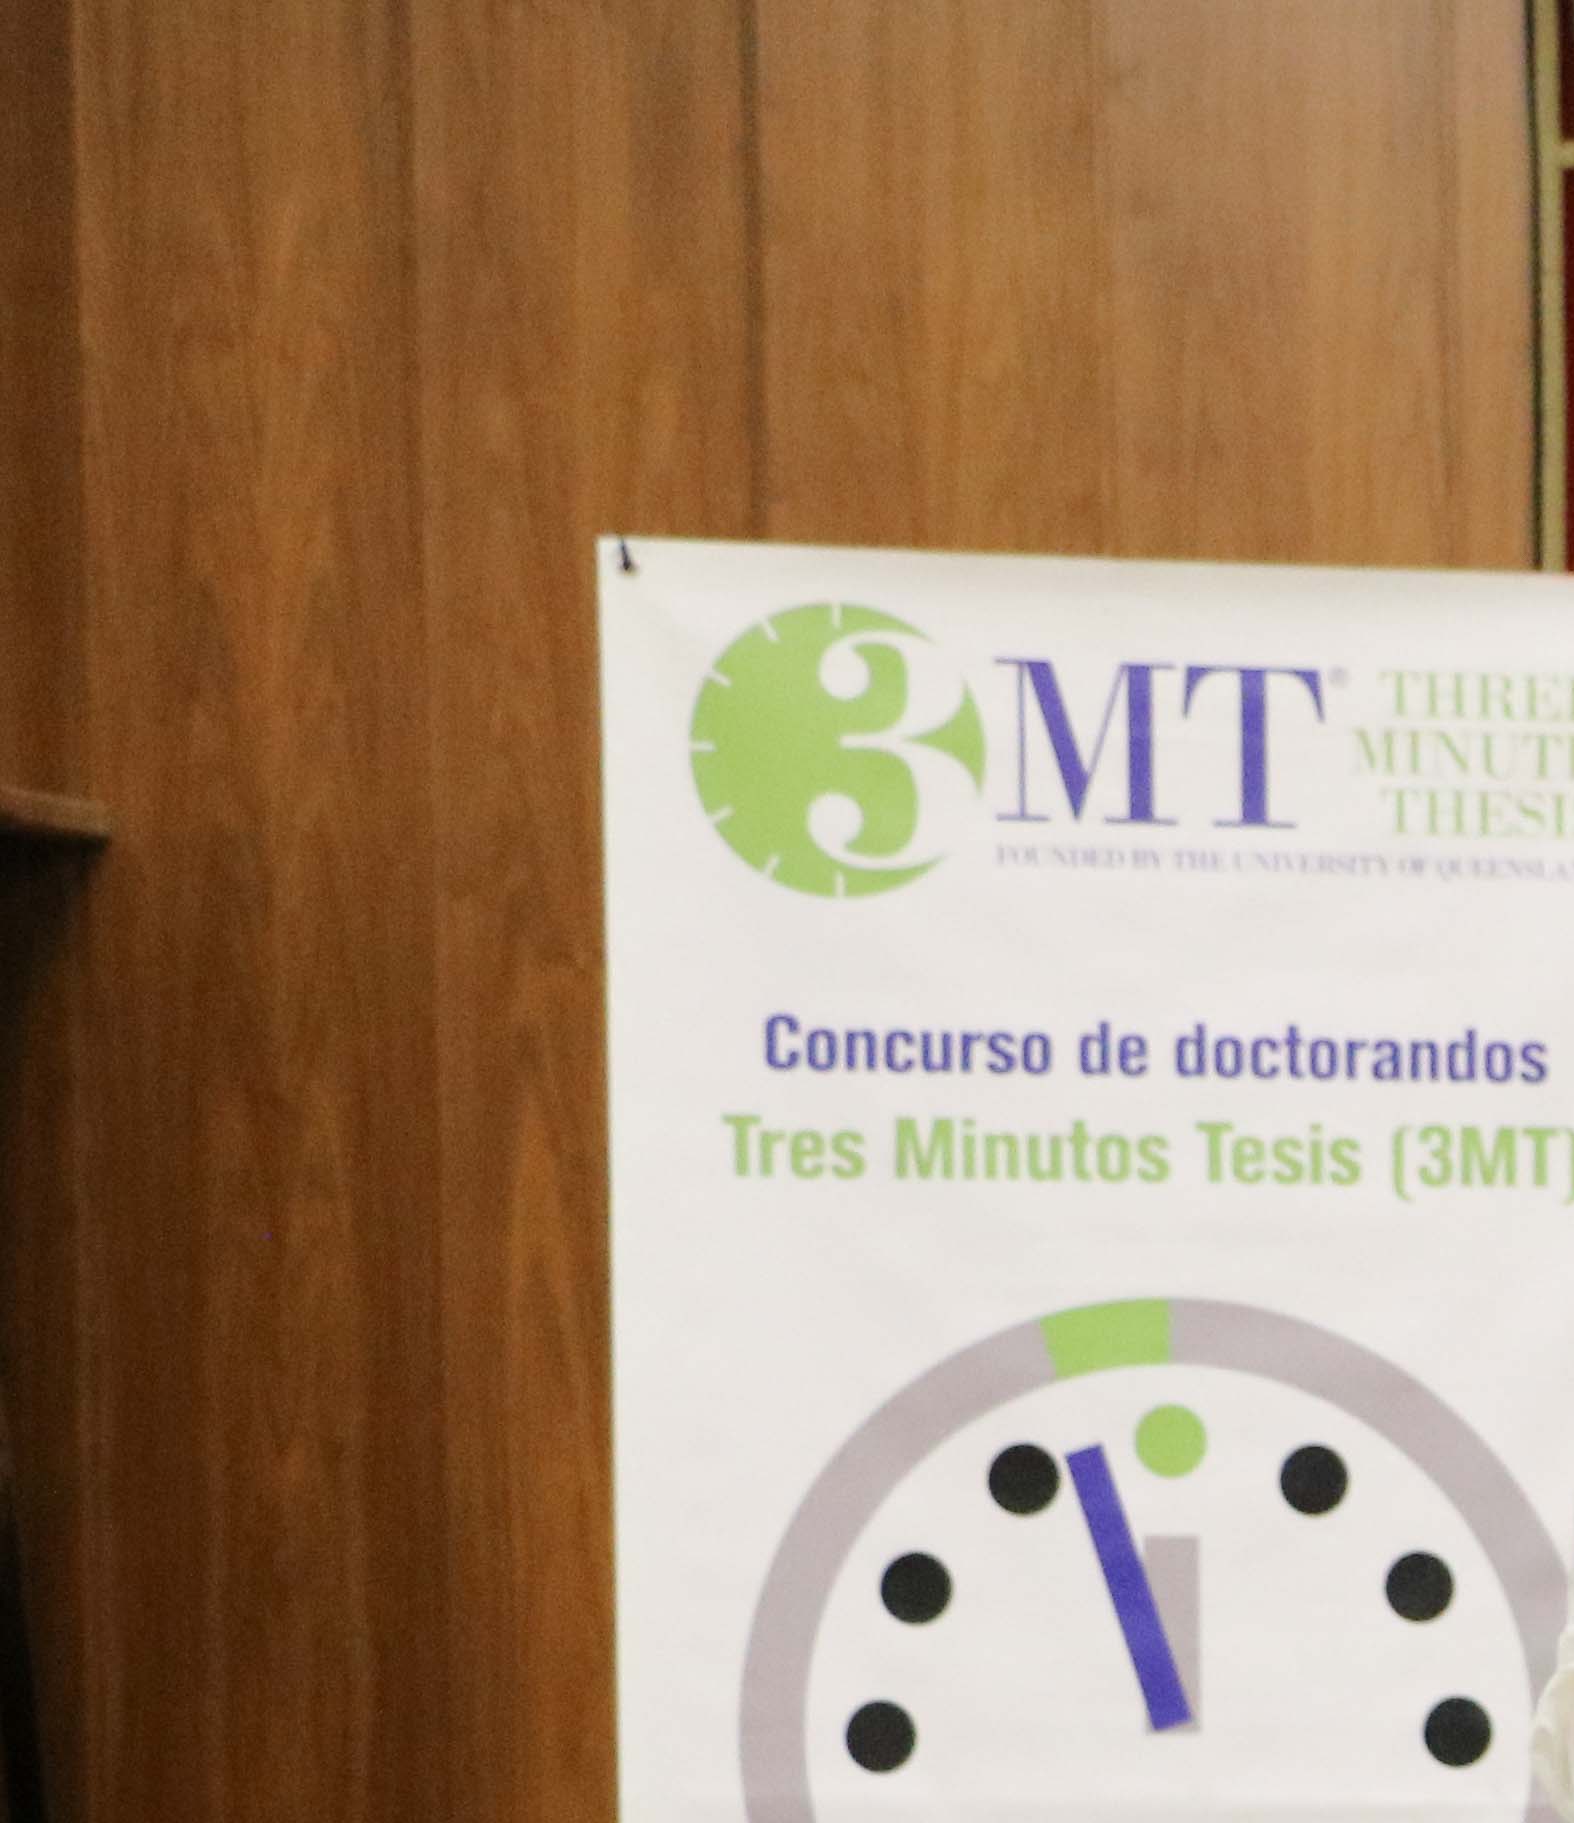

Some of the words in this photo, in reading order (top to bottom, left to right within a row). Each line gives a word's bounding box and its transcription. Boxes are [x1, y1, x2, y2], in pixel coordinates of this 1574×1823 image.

[996, 845, 1125, 870] FOUNDED
[1131, 849, 1162, 872] BY
[1172, 849, 1225, 874] THE
[1232, 850, 1390, 878] UNIVERSITY
[1398, 855, 1428, 878] OF
[763, 1011, 1053, 1076] Concurso
[1078, 1020, 1150, 1078] de
[1174, 1022, 1550, 1085] doctorandos
[722, 1112, 866, 1181] Tres
[893, 1116, 1171, 1184] Minutos
[1196, 1118, 1362, 1187] Tesis
